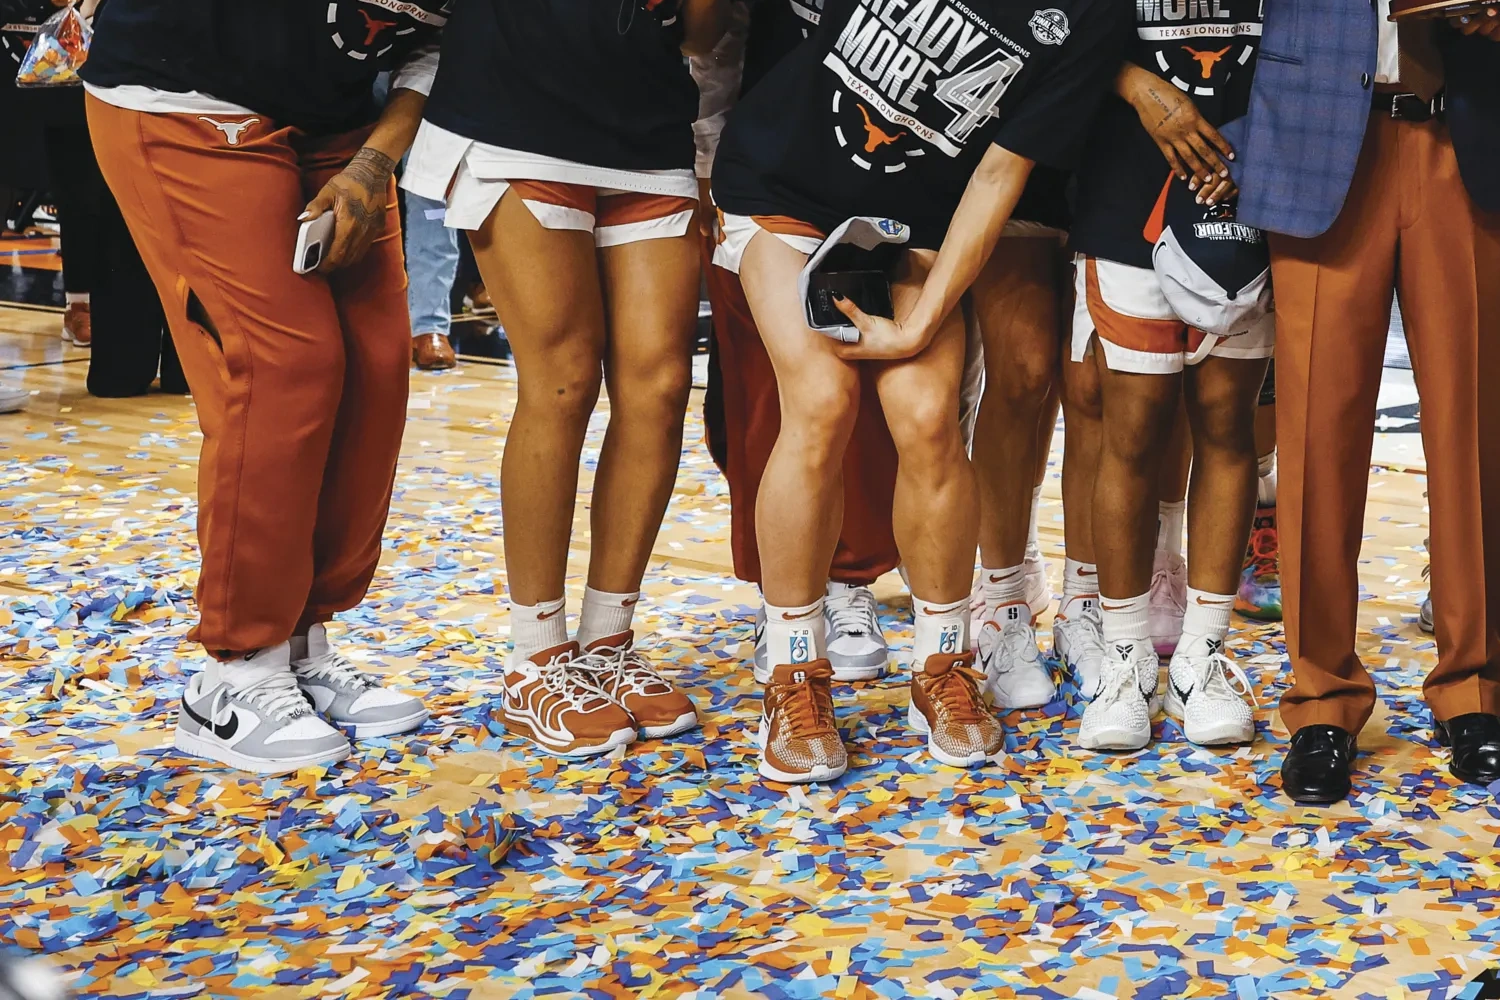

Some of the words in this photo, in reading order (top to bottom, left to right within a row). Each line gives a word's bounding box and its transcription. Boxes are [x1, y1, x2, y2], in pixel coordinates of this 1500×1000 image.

[955, 0, 989, 31] REGIONAL
[989, 27, 1031, 58] CHAMPIONS
[1033, 15, 1051, 29] FINAL
[1050, 25, 1065, 40] FOUR
[1159, 27, 1191, 37] TEXAS
[834, 3, 942, 113] MORE
[846, 75, 875, 101] TEXAS
[876, 99, 935, 140] LONGHORNS
[933, 47, 1024, 144] 4
[951, 89, 972, 107] FINAL
[1196, 222, 1230, 239] FOUR
